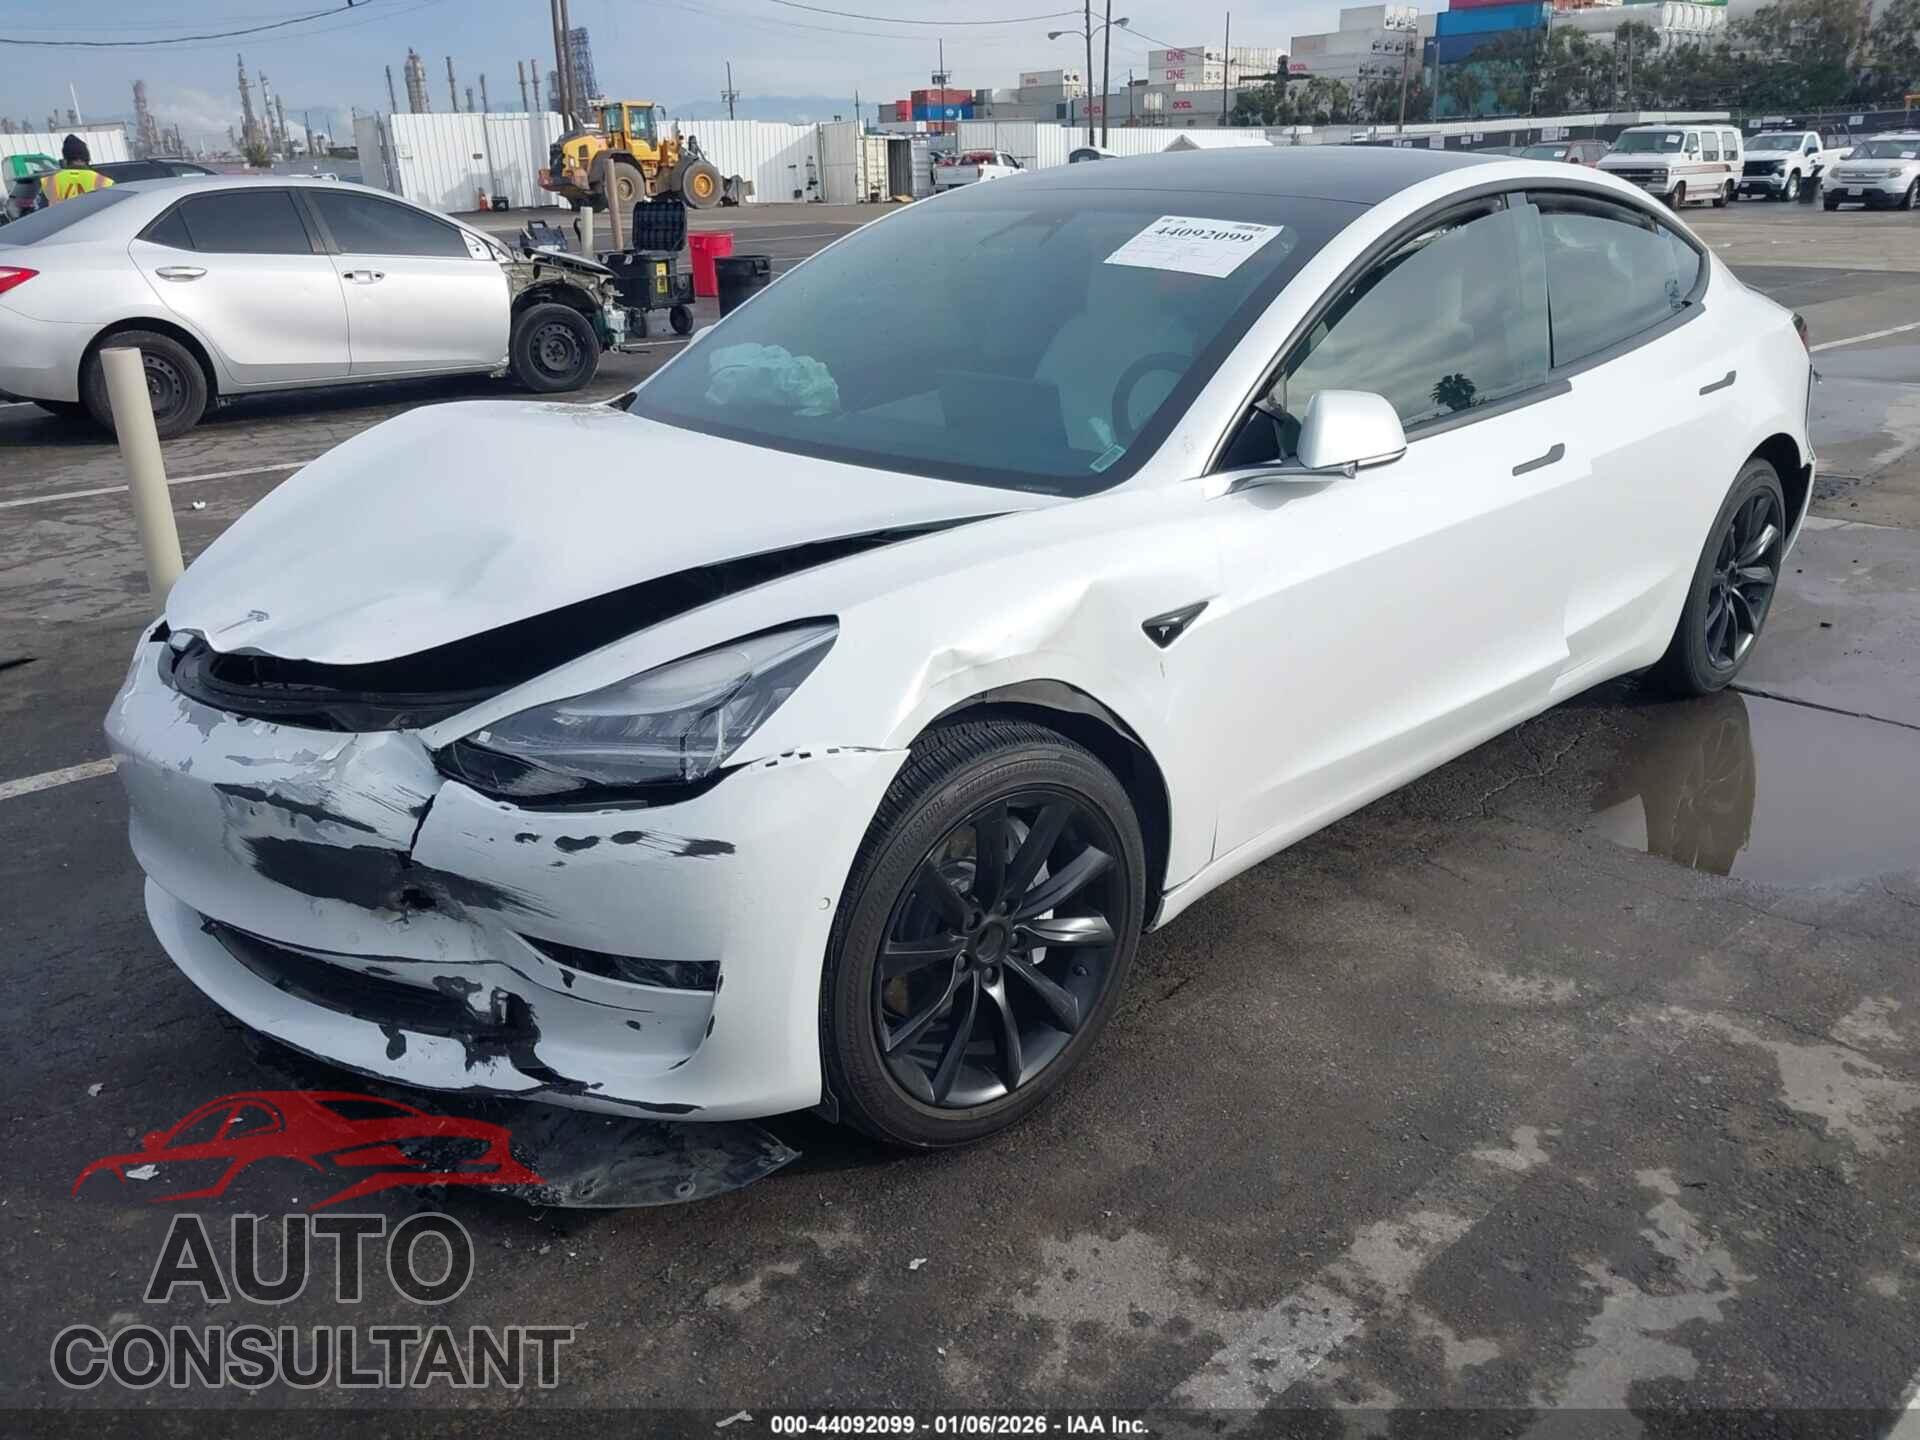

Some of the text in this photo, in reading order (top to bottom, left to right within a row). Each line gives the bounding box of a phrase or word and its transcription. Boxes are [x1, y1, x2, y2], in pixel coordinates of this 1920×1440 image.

[1166, 49, 1185, 61] ONE
[1166, 69, 1184, 80] ONE
[1154, 226, 1254, 243] 44092099
